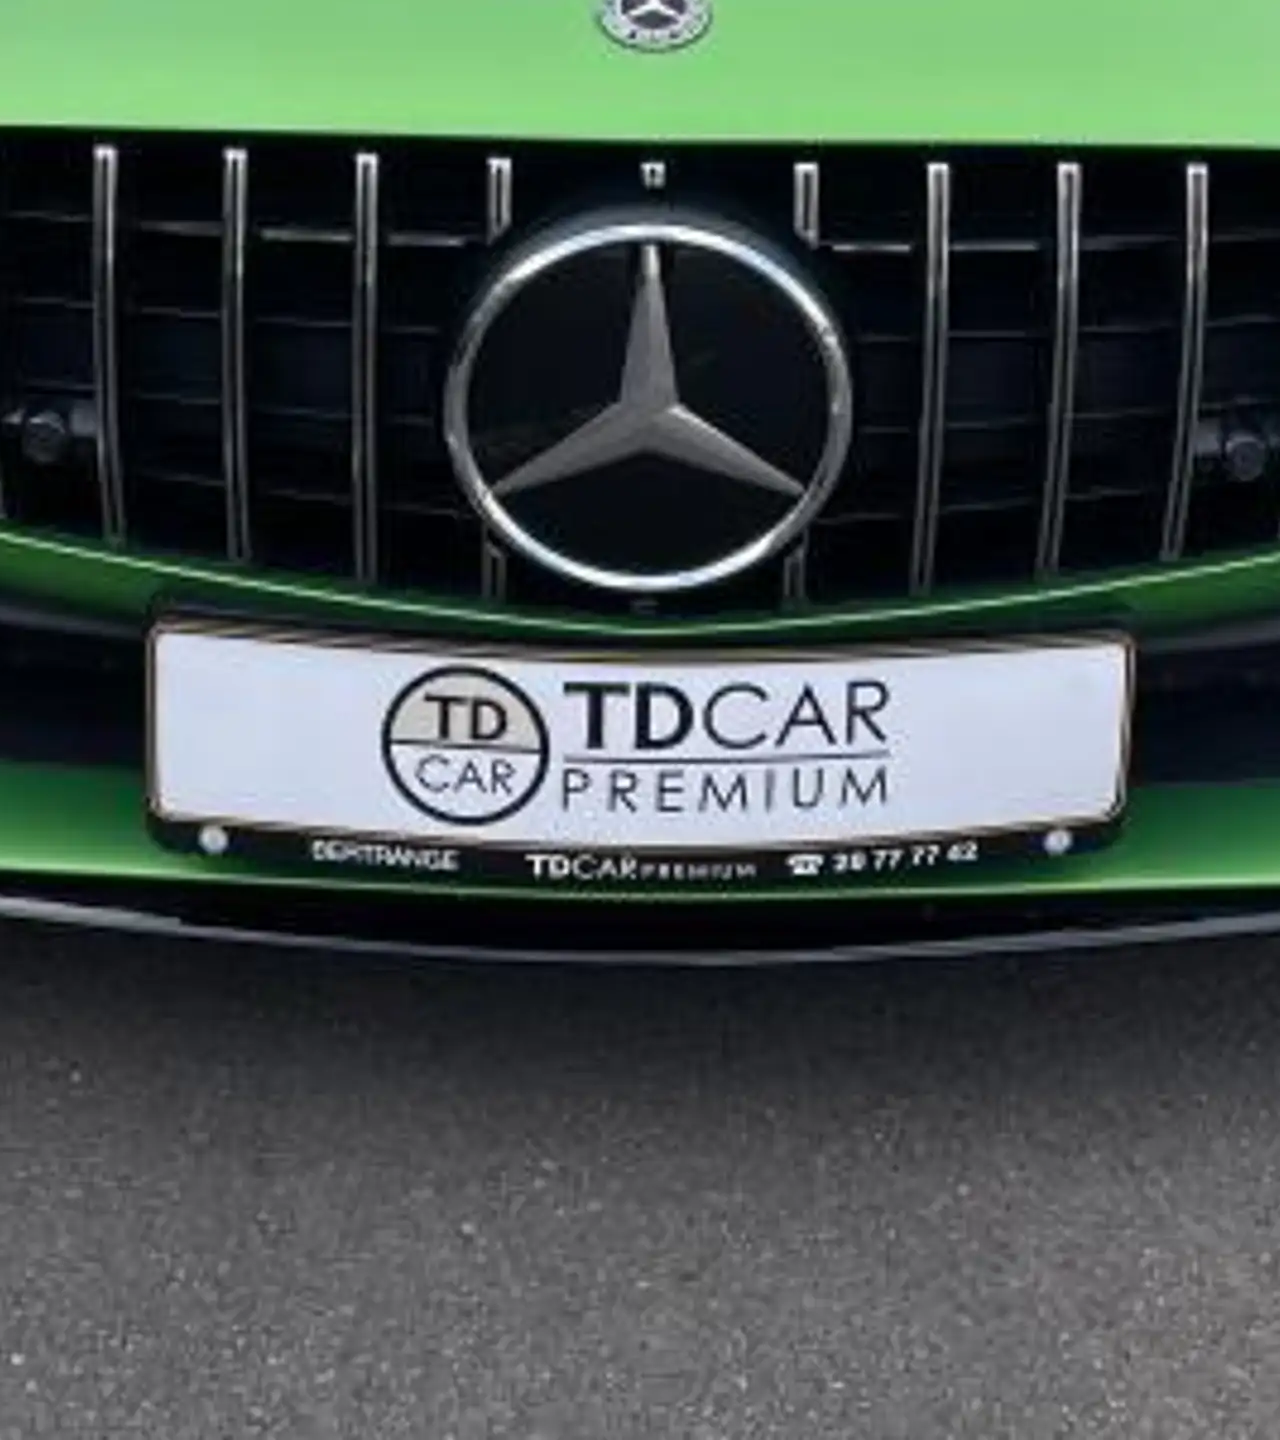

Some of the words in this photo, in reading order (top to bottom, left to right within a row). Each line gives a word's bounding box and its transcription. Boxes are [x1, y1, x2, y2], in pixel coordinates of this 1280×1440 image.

[424, 694, 508, 742] TD
[563, 680, 891, 751] TDCAR
[415, 754, 516, 796] CAR
[561, 766, 888, 813] PREMIUM
